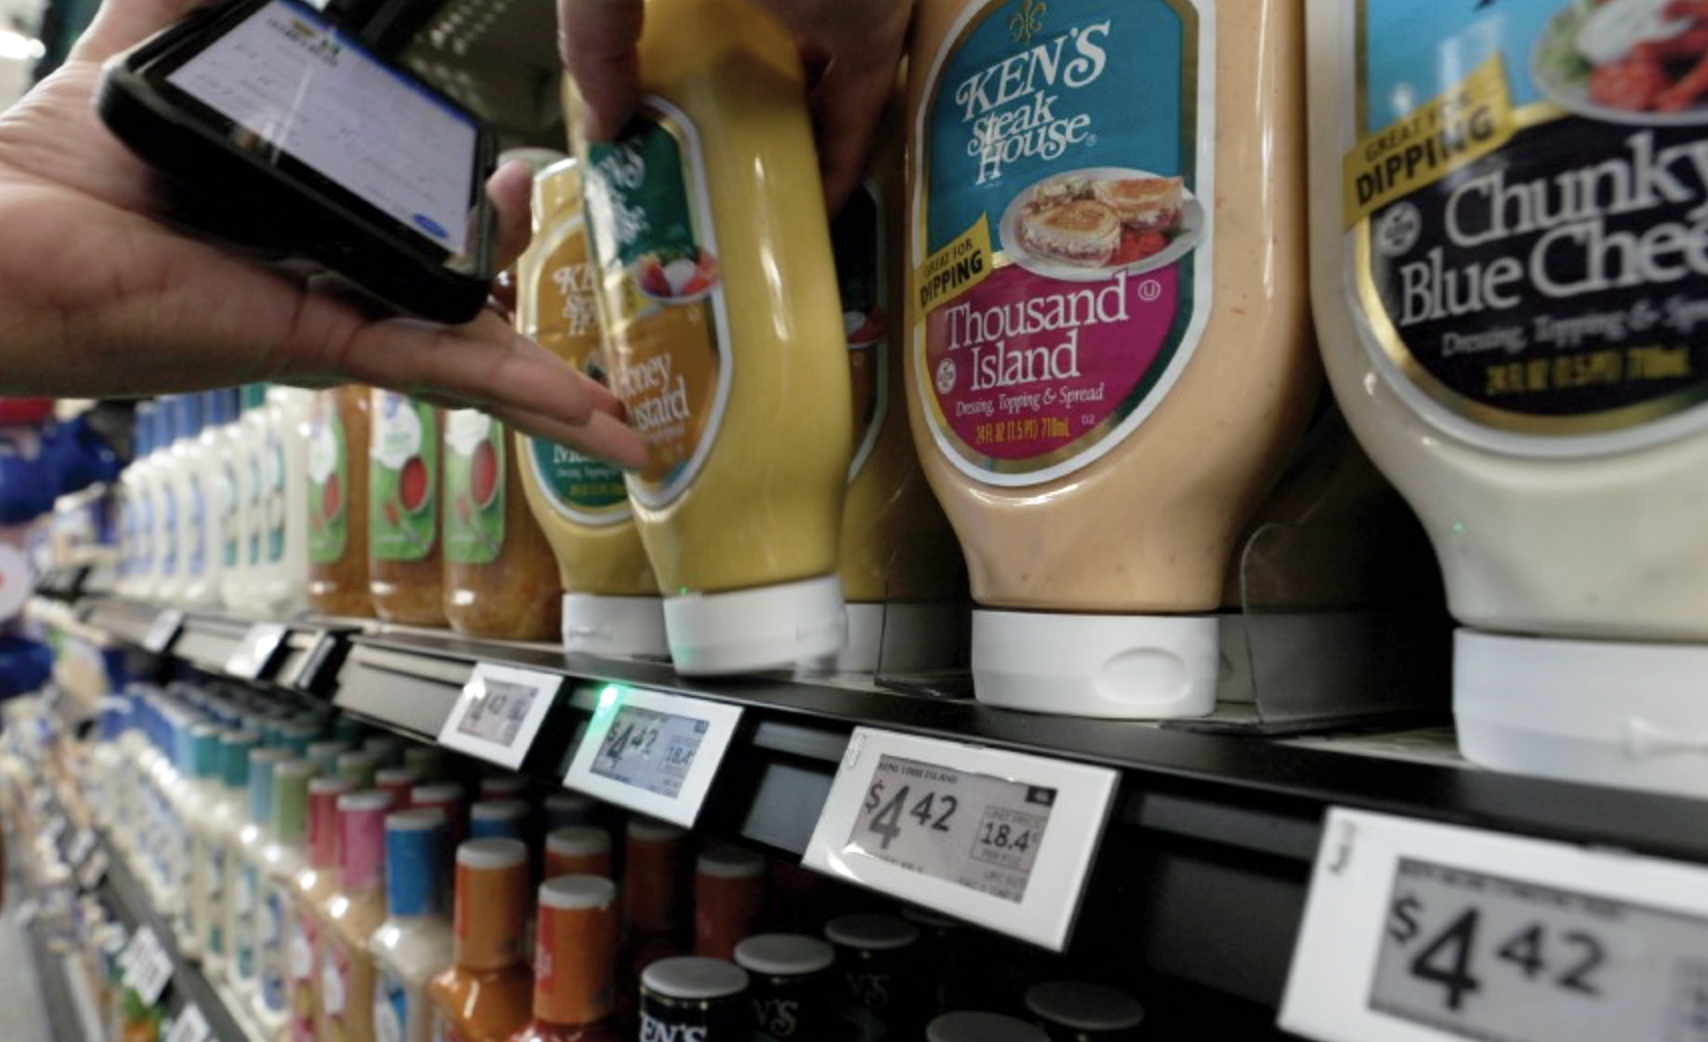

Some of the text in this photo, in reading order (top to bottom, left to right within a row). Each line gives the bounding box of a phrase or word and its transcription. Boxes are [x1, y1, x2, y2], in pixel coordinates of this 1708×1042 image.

[955, 19, 1112, 122] KEN'S
[1355, 104, 1495, 207] DIPPING
[919, 248, 984, 309] DIPPING
[952, 237, 974, 260] FOR
[945, 268, 1130, 351] Thousand
[1400, 246, 1524, 327] Blue
[969, 329, 1082, 392] Island
[998, 391, 1042, 415] Topping
[1043, 386, 1057, 406] &
[1059, 381, 1106, 409] Spread
